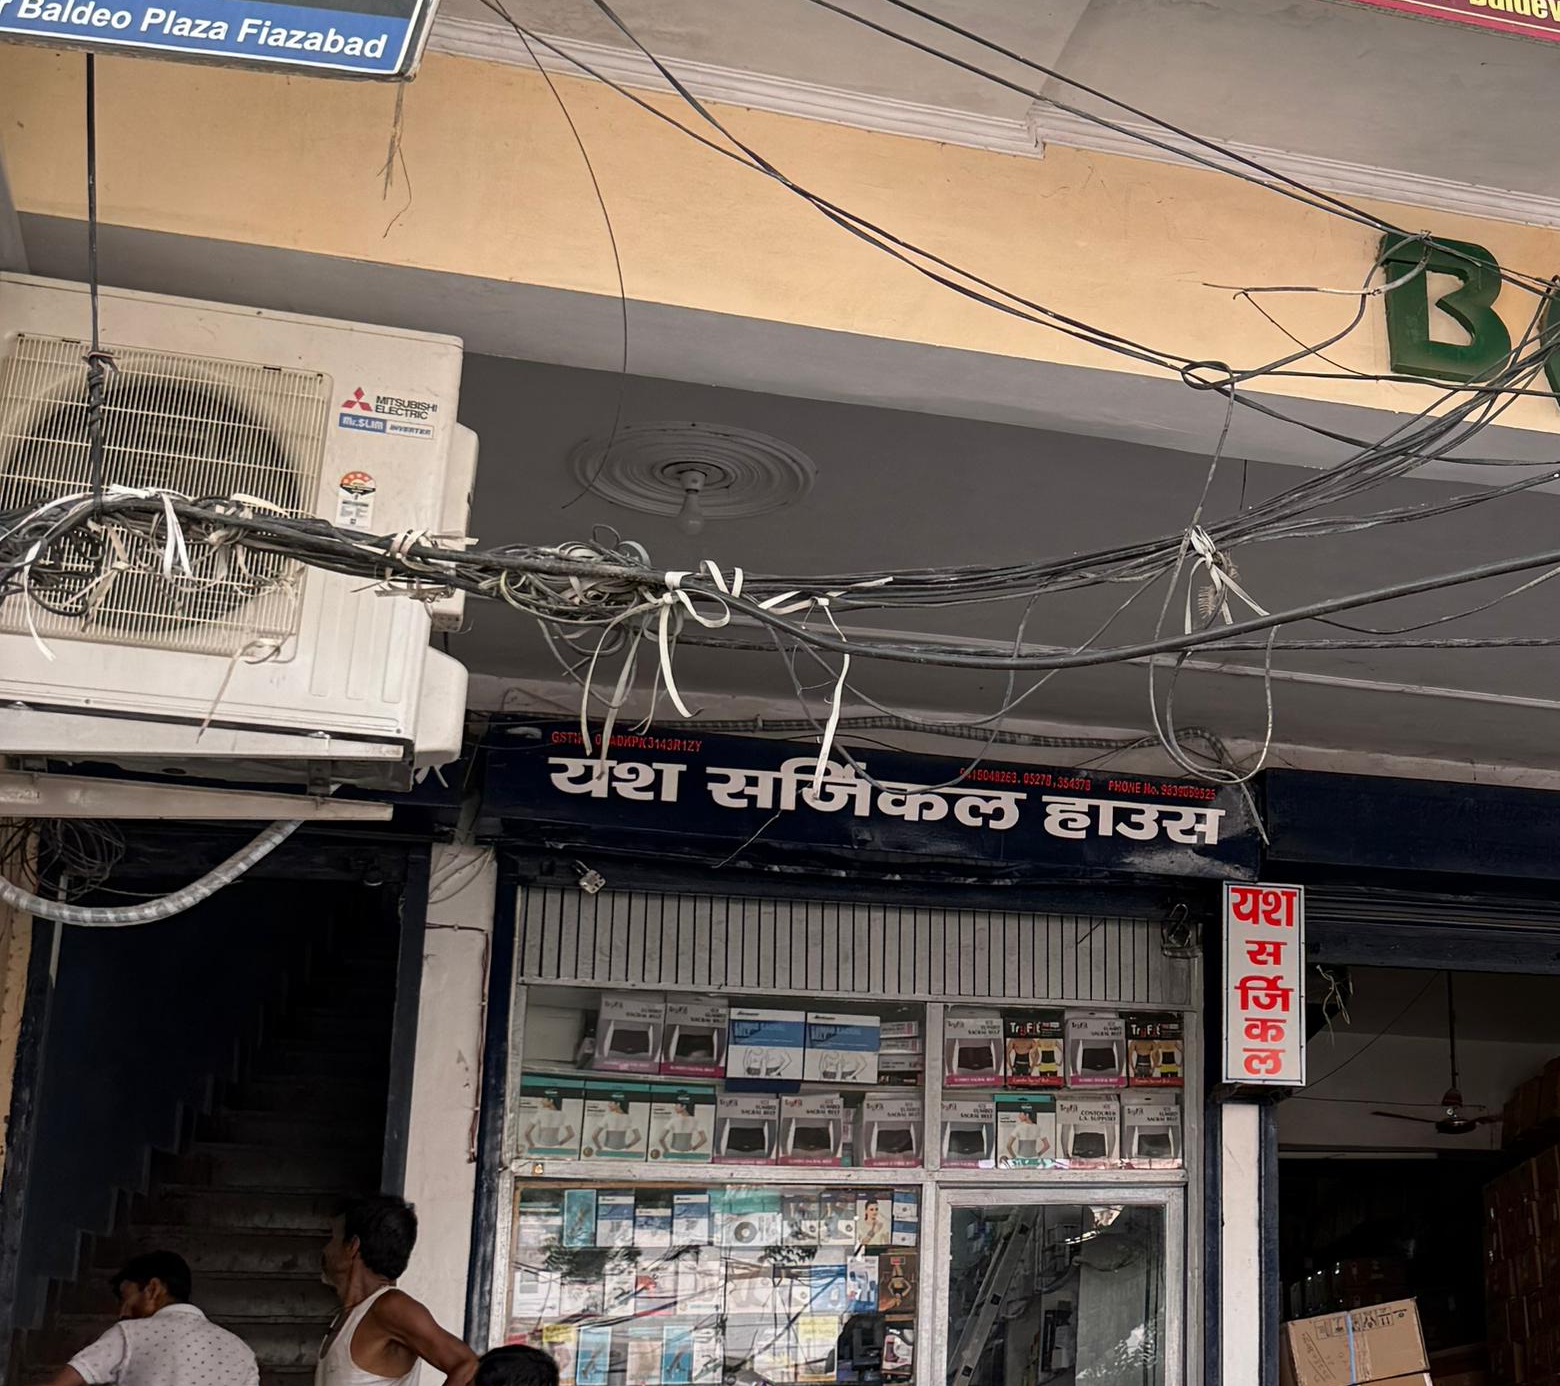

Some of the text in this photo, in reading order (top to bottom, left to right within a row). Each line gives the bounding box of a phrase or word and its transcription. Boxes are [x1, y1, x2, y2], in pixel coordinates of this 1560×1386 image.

[140, 6, 229, 42] Plaza
[236, 17, 389, 60] Fiazabad
[375, 405, 428, 420] ELECTRIC
[376, 395, 438, 413] MITSUBISHI
[548, 756, 1226, 846] यश सर्जिकल हाउस
[1107, 780, 1141, 795] PHONE
[1231, 887, 1298, 927] यश
